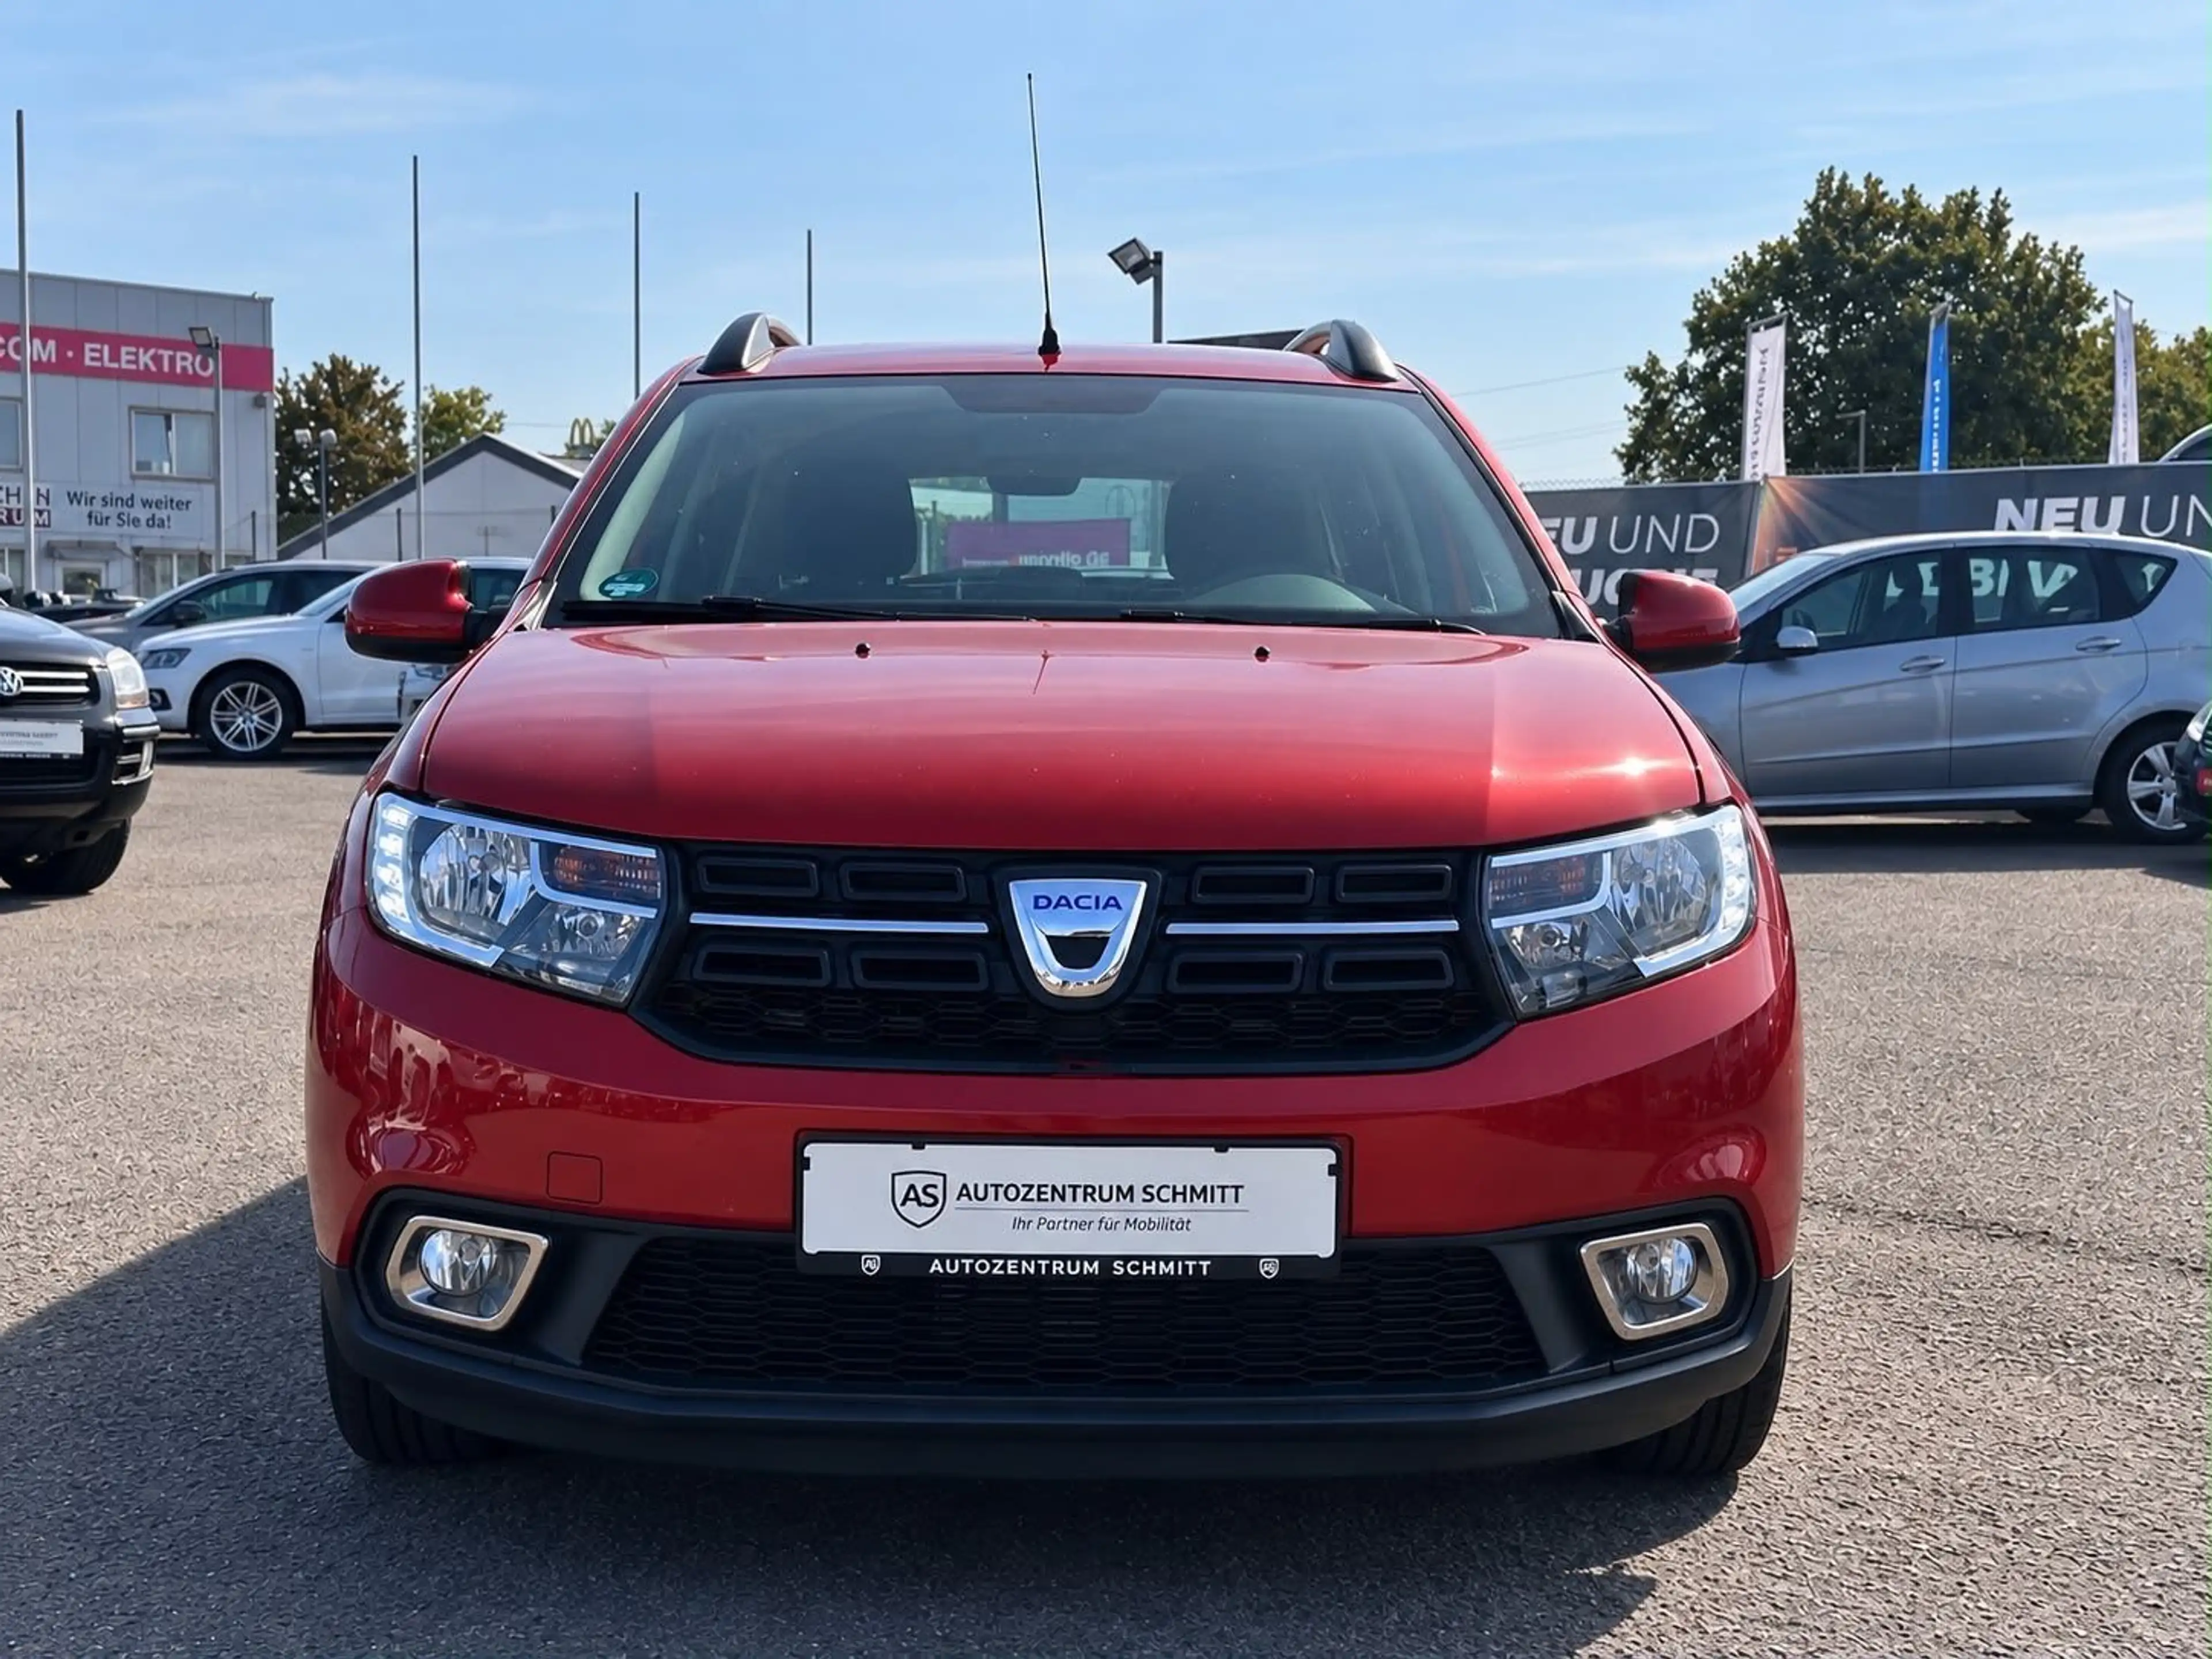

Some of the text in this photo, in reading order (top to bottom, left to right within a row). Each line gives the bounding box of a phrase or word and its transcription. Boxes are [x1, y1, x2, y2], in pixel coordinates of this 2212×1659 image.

[84, 342, 214, 377] ELEKTRO
[67, 491, 192, 512] Wir sind weiter
[87, 510, 171, 529] für Sie da!
[1994, 496, 2126, 532] NEU
[1609, 513, 1719, 554] UND
[1033, 895, 1123, 910] DACIA
[900, 1184, 939, 1207] AS
[956, 1183, 1244, 1203] AUTOZENTRUM SCHMITT
[1012, 1215, 1191, 1232] Ihr Partner für Mobilität
[929, 1259, 1211, 1276] AUTOZENTRUM SCHMITT
